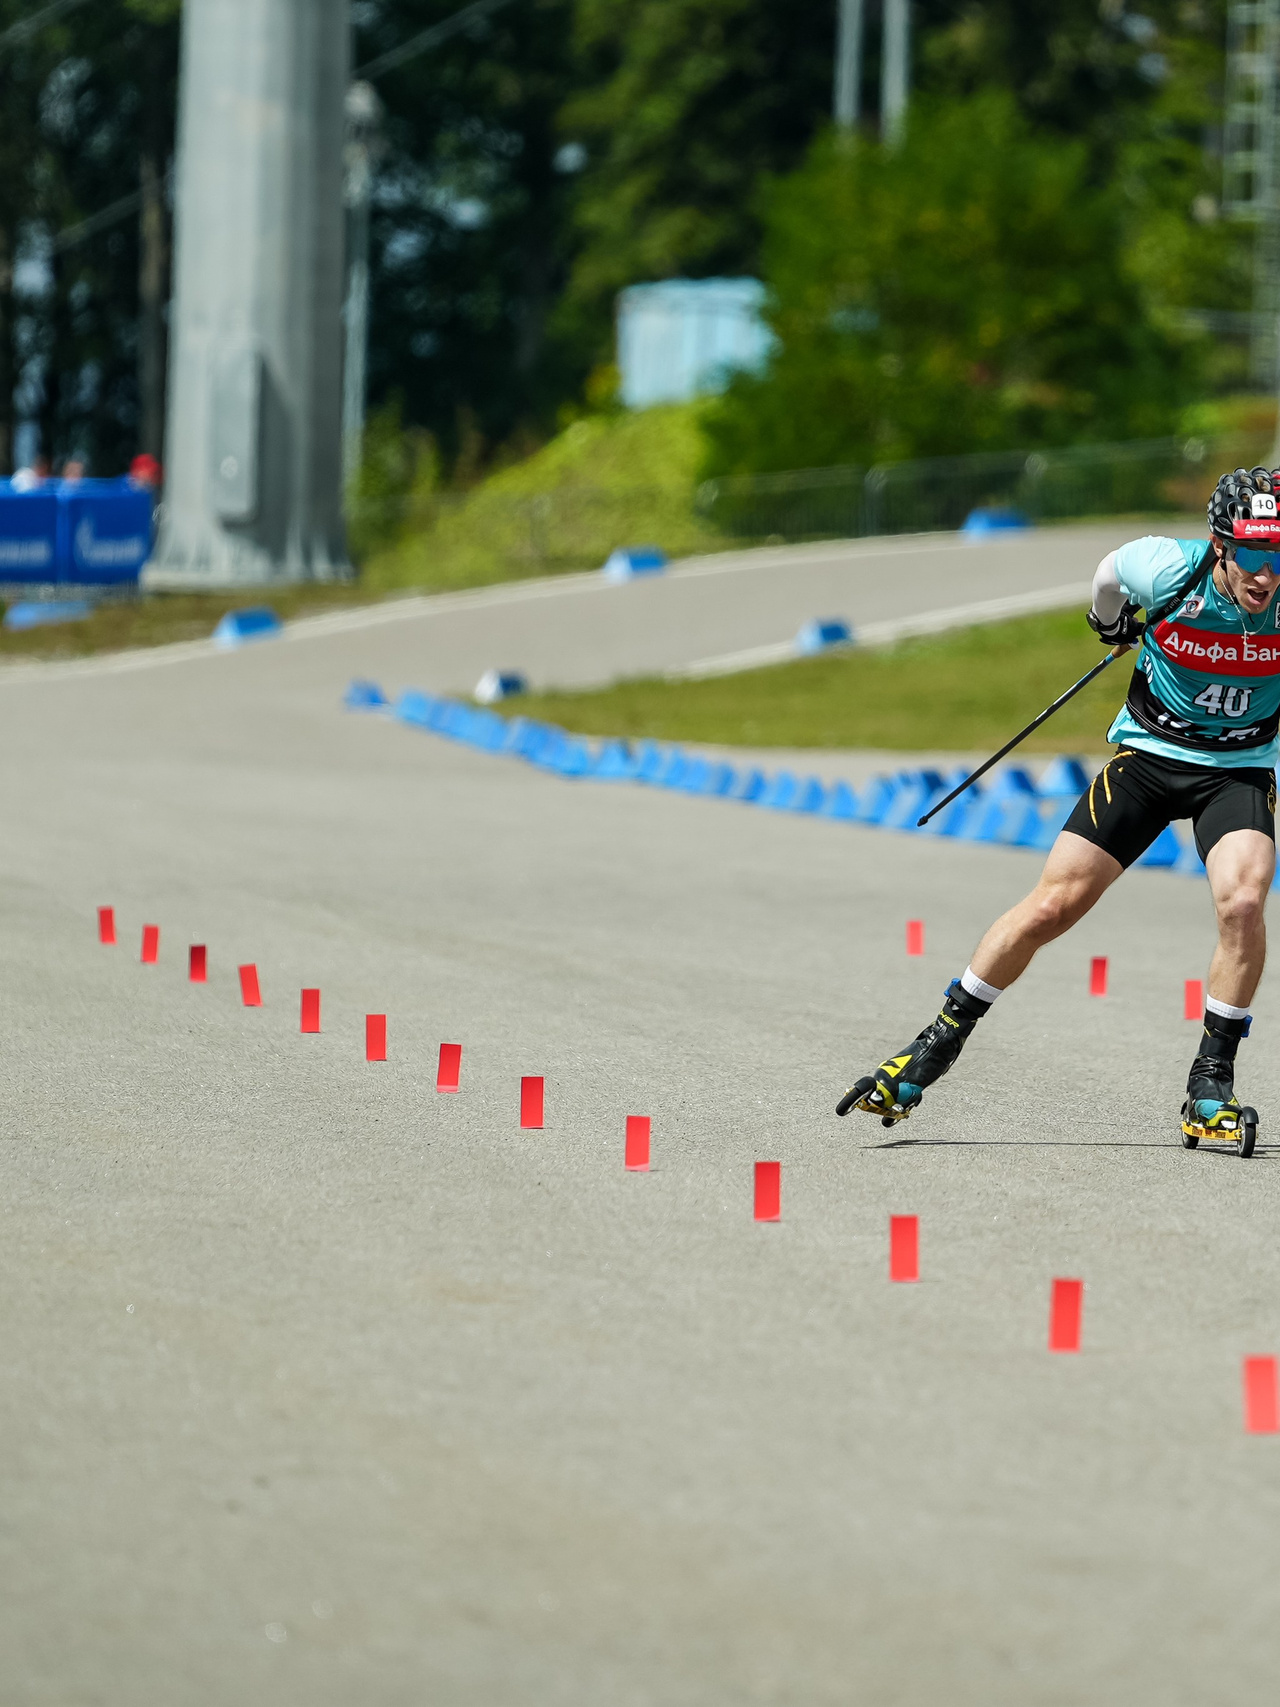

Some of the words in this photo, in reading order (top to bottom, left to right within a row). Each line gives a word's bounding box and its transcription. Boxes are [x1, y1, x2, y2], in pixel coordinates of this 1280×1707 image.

[1253, 499, 1274, 511] 40
[1245, 523, 1270, 533] Альфа
[1163, 630, 1238, 663] Альфа
[1193, 683, 1254, 718] 40
